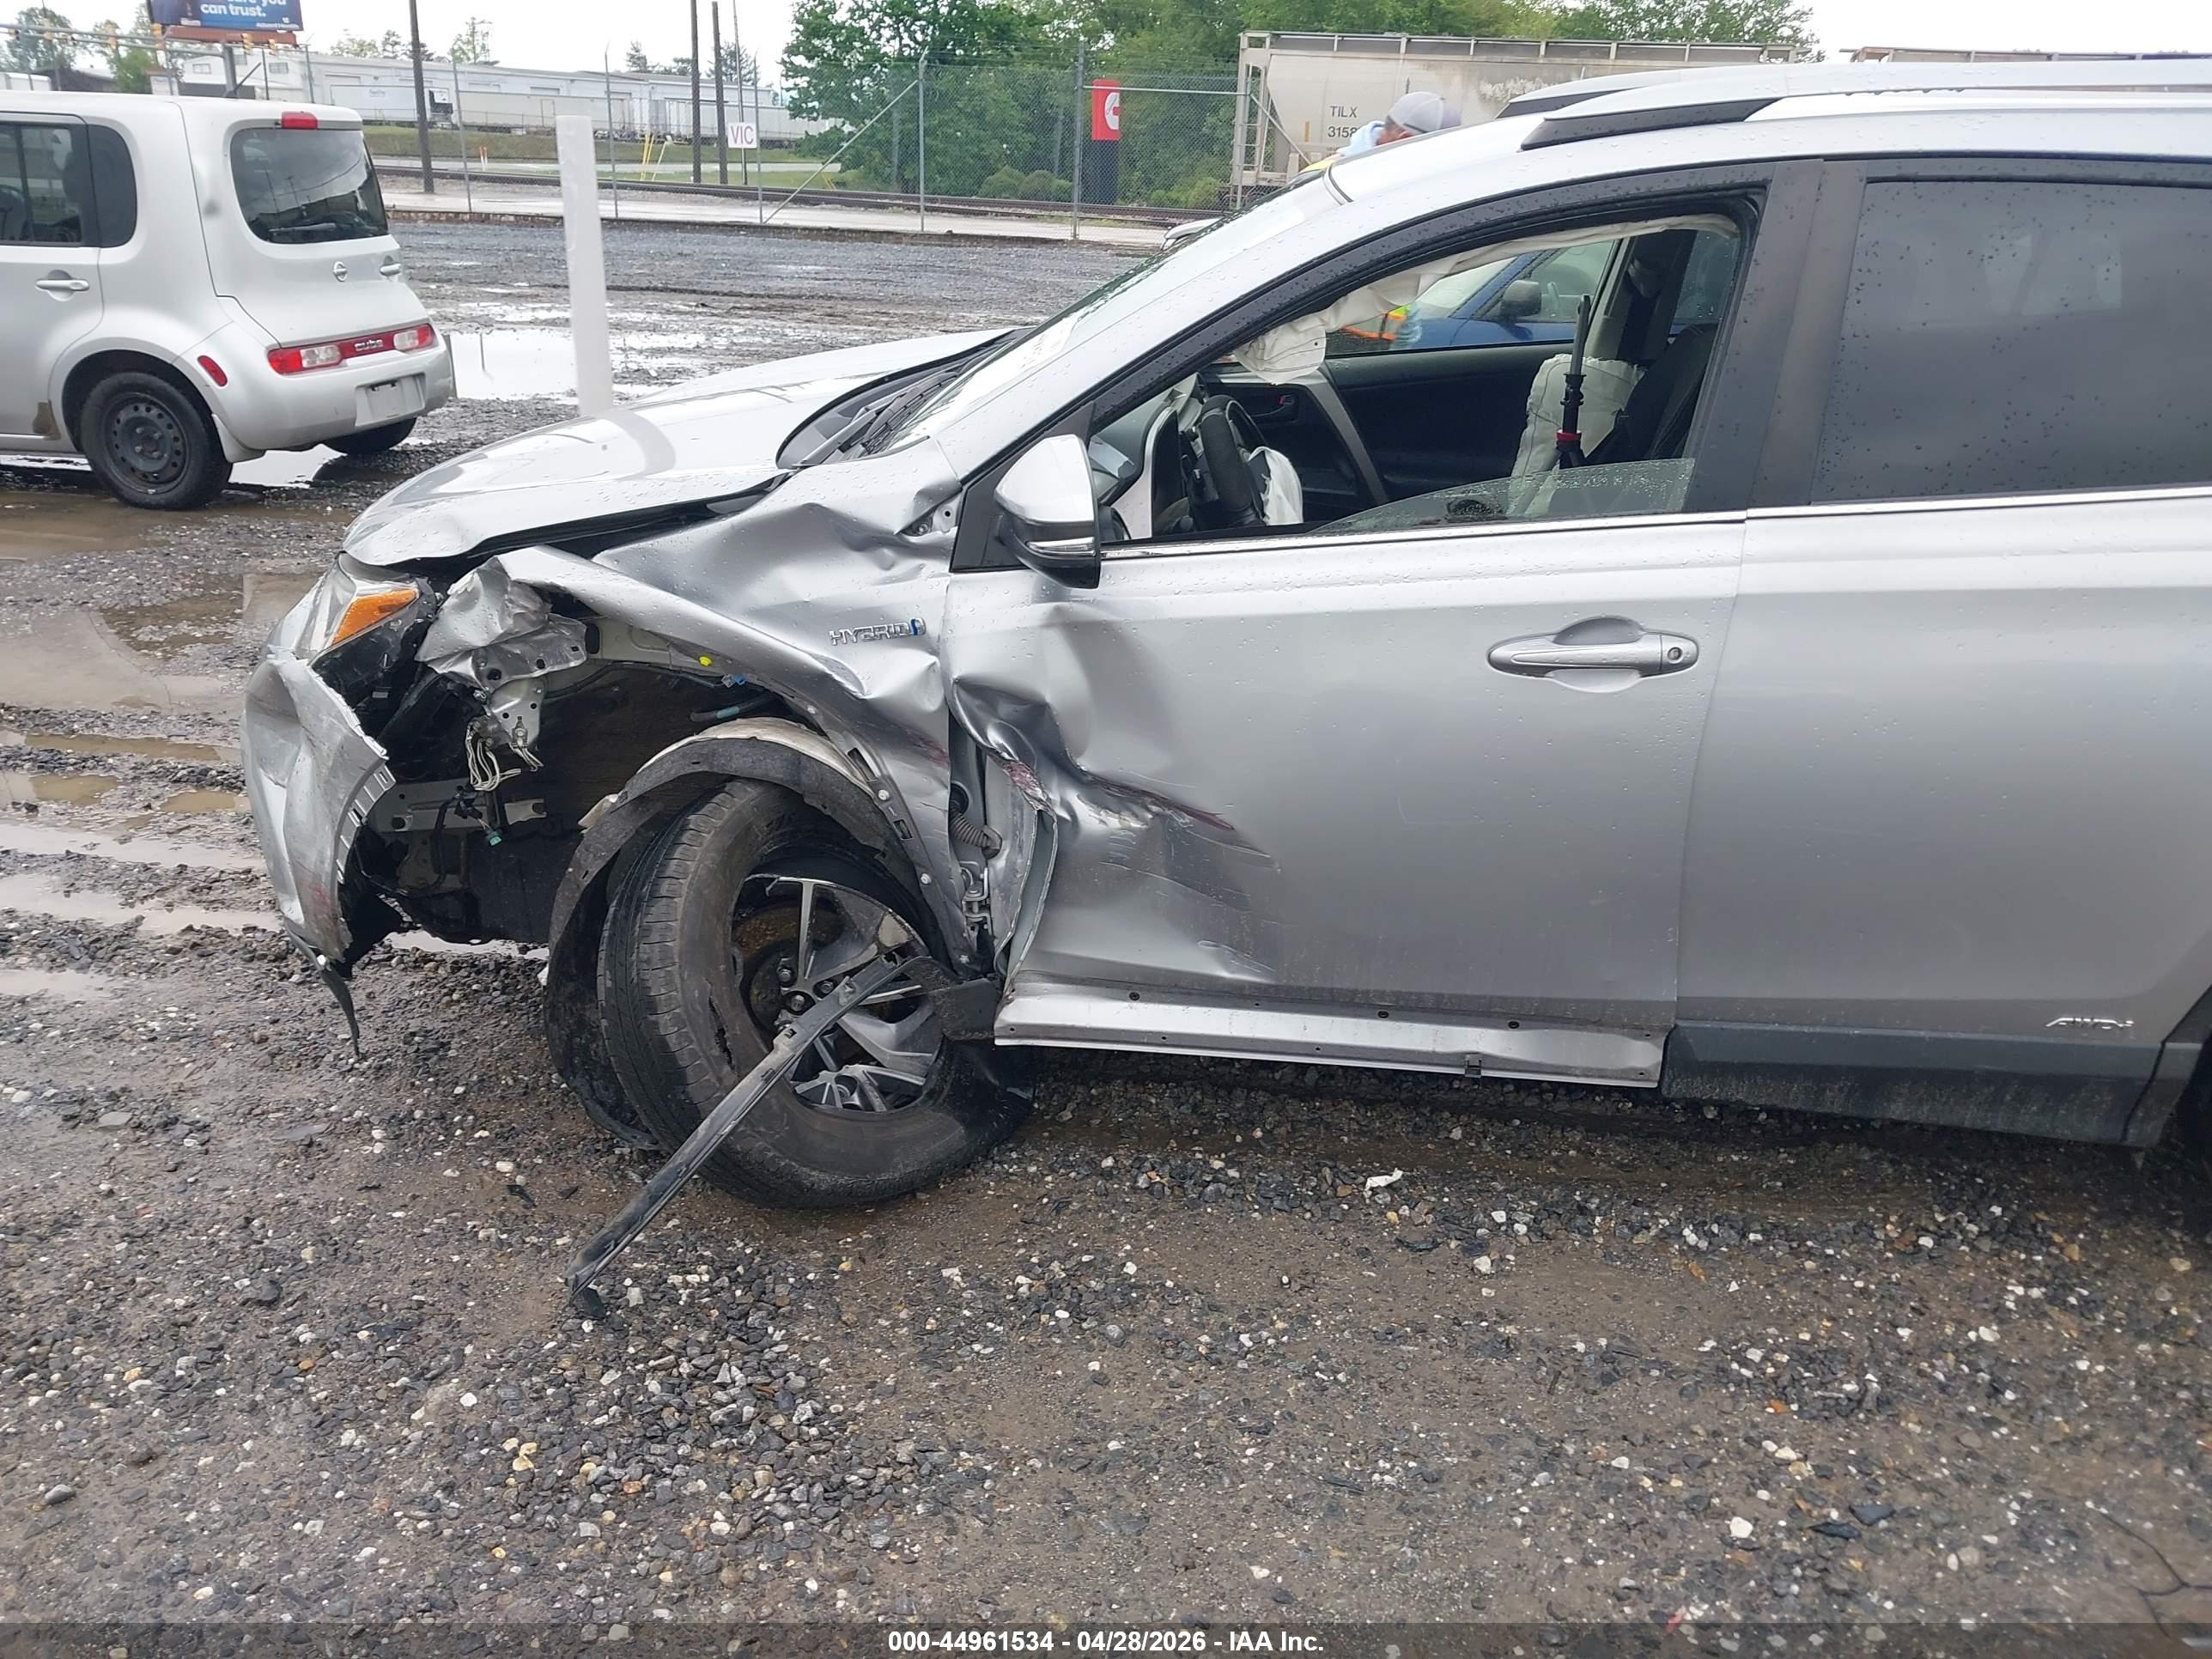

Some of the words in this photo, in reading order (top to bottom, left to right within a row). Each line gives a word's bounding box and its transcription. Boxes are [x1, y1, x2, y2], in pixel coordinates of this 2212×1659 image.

[200, 3, 228, 15] can
[228, 3, 267, 17] trust.
[1329, 106, 1358, 118] TILX
[730, 125, 754, 145] VIC
[828, 622, 911, 646] HYBRID
